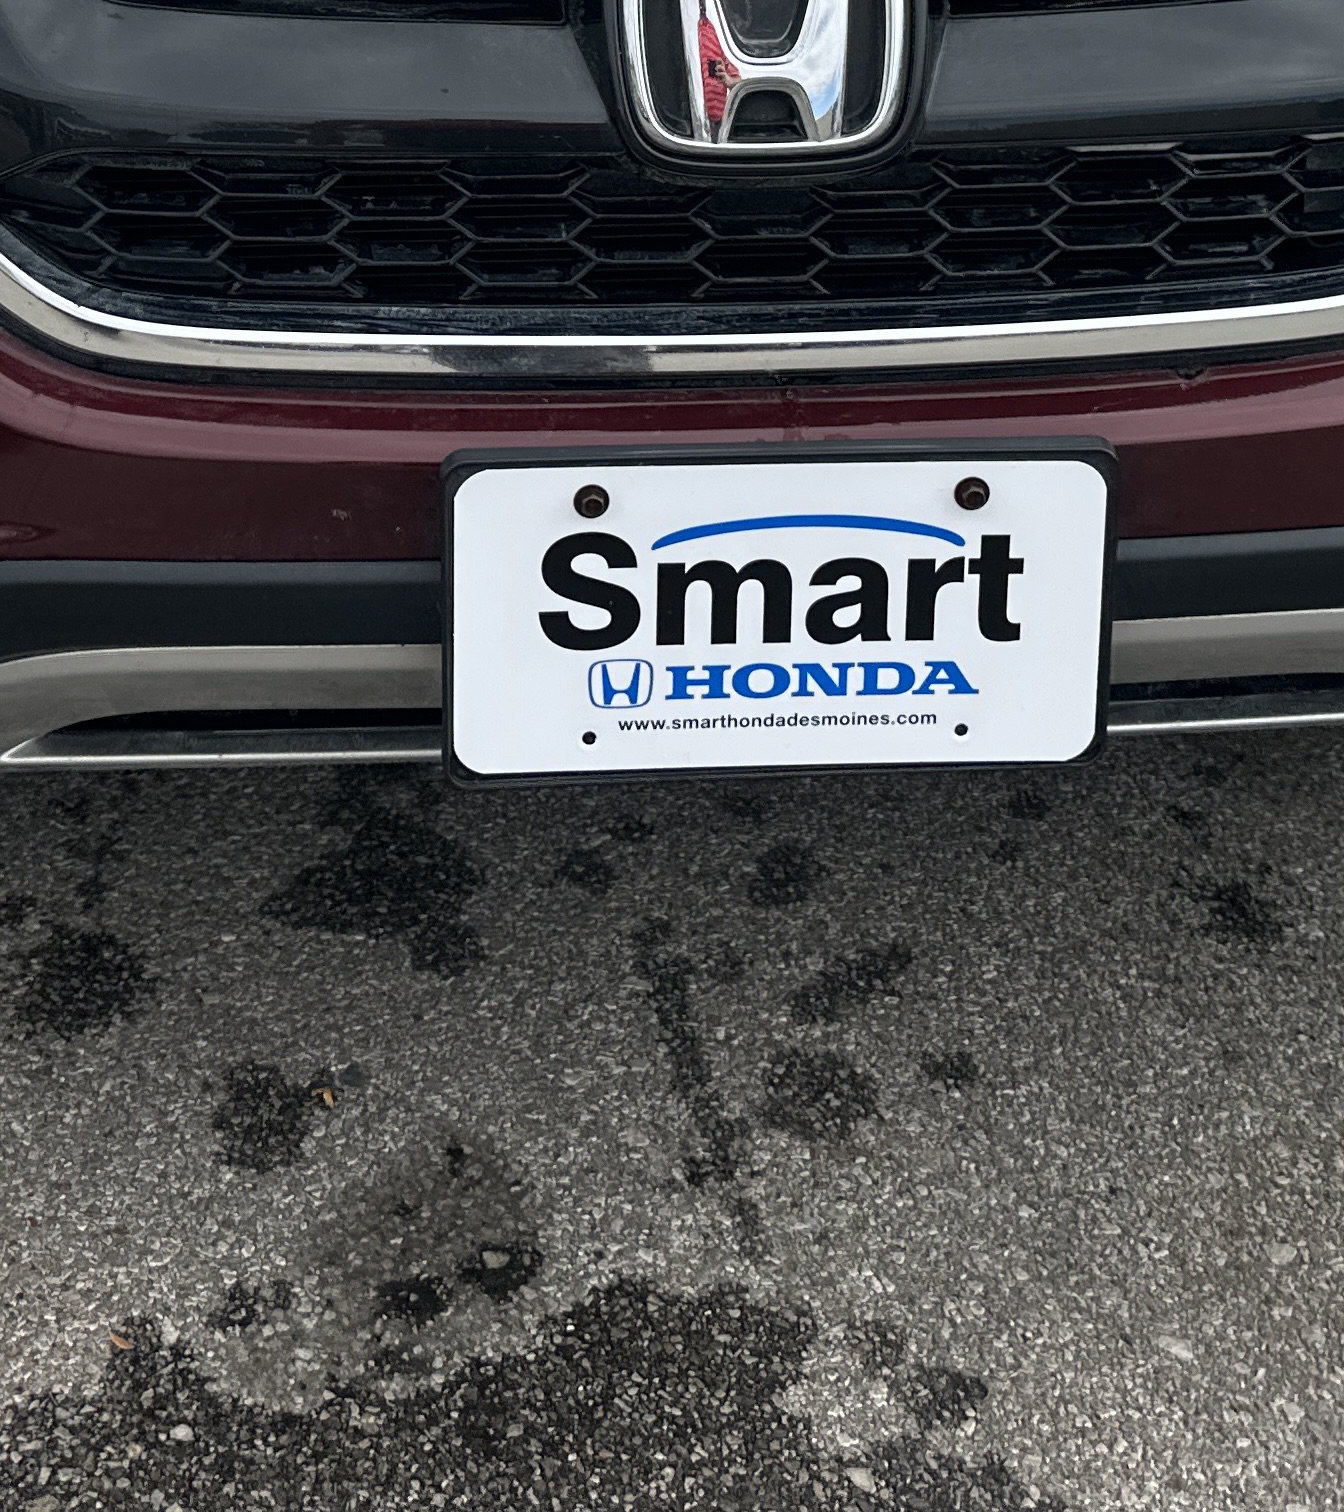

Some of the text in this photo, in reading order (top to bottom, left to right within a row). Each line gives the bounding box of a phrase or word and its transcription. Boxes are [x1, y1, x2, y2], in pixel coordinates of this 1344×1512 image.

[538, 530, 1025, 651] Smart
[665, 661, 979, 700] HONDA
[618, 712, 937, 732] www.smarthondadesmoines.com
